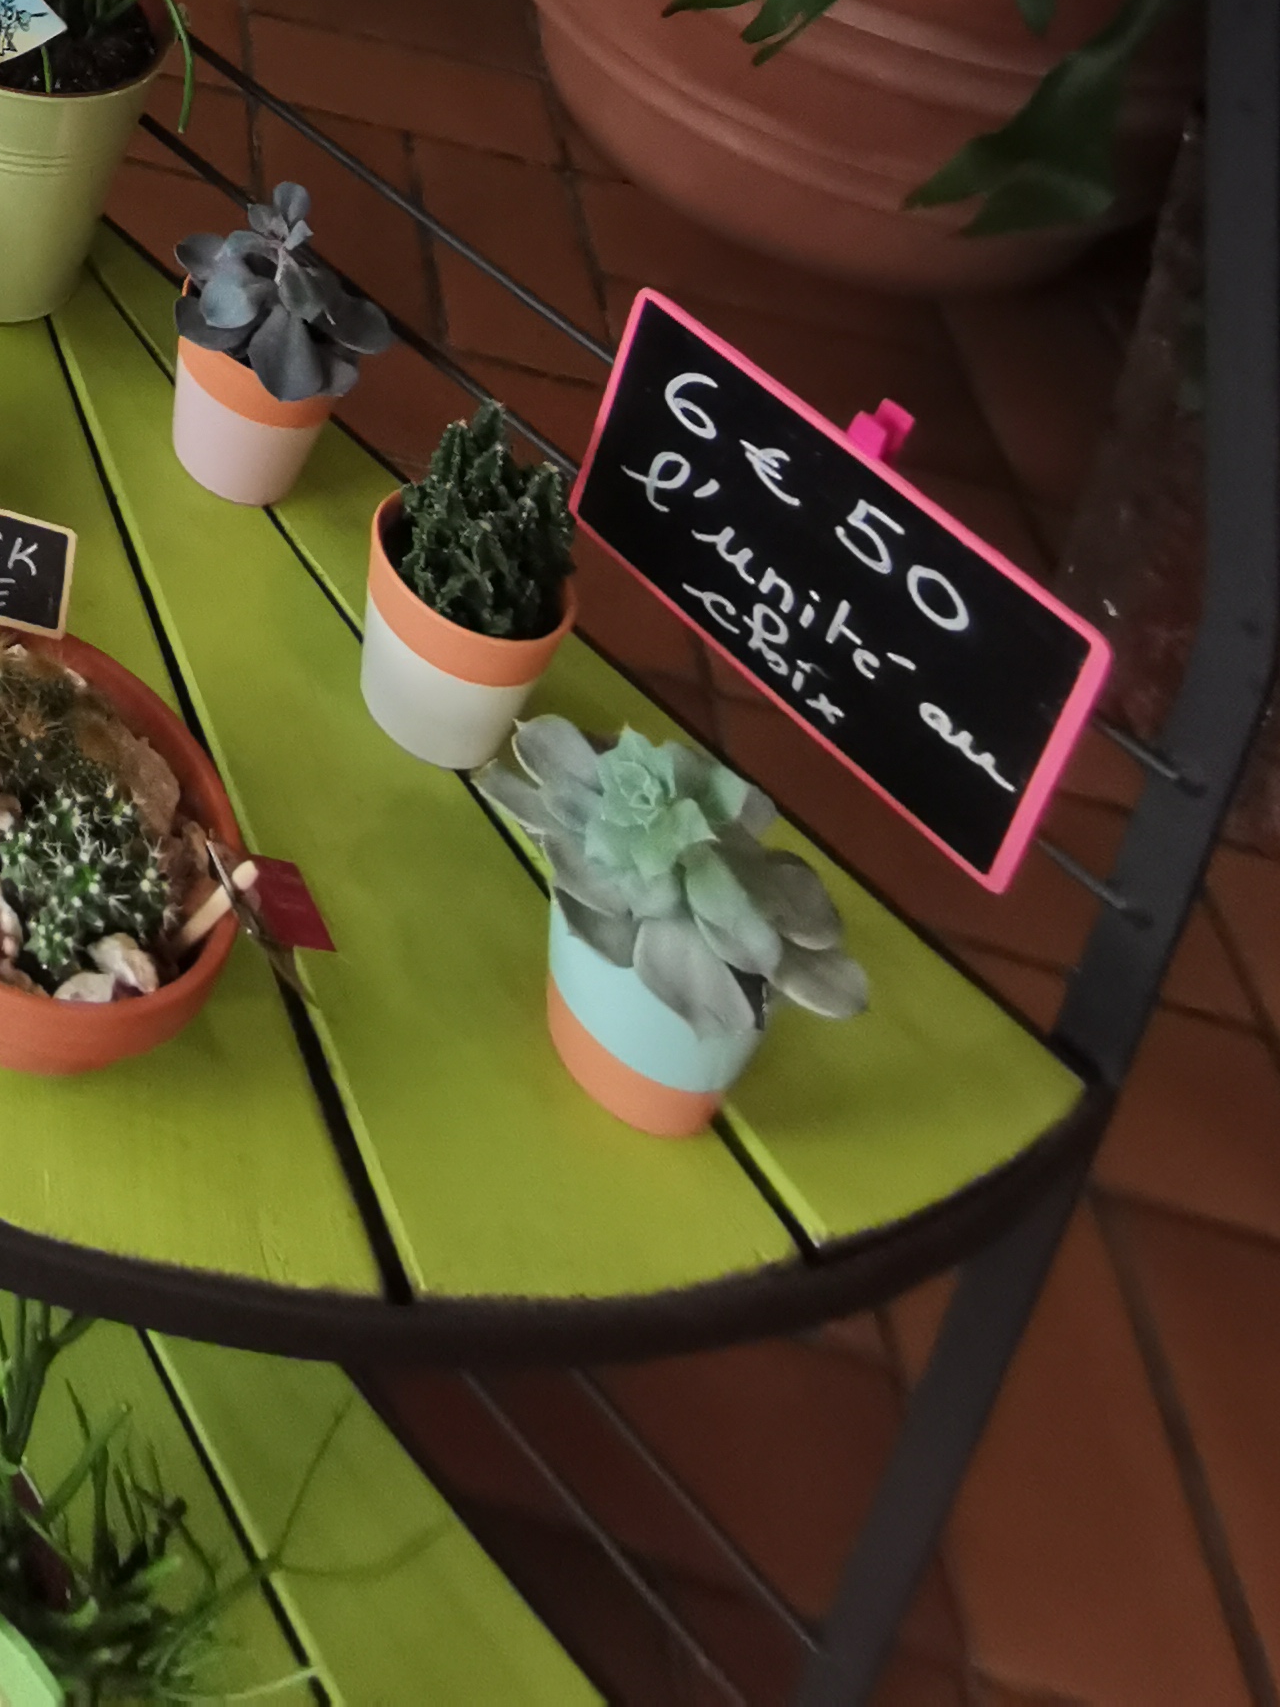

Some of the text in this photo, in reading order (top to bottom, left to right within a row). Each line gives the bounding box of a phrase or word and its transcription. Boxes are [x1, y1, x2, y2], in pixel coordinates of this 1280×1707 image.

[664, 372, 970, 632] 6 € 50
[681, 582, 846, 725] choix
[918, 701, 1016, 793] au
